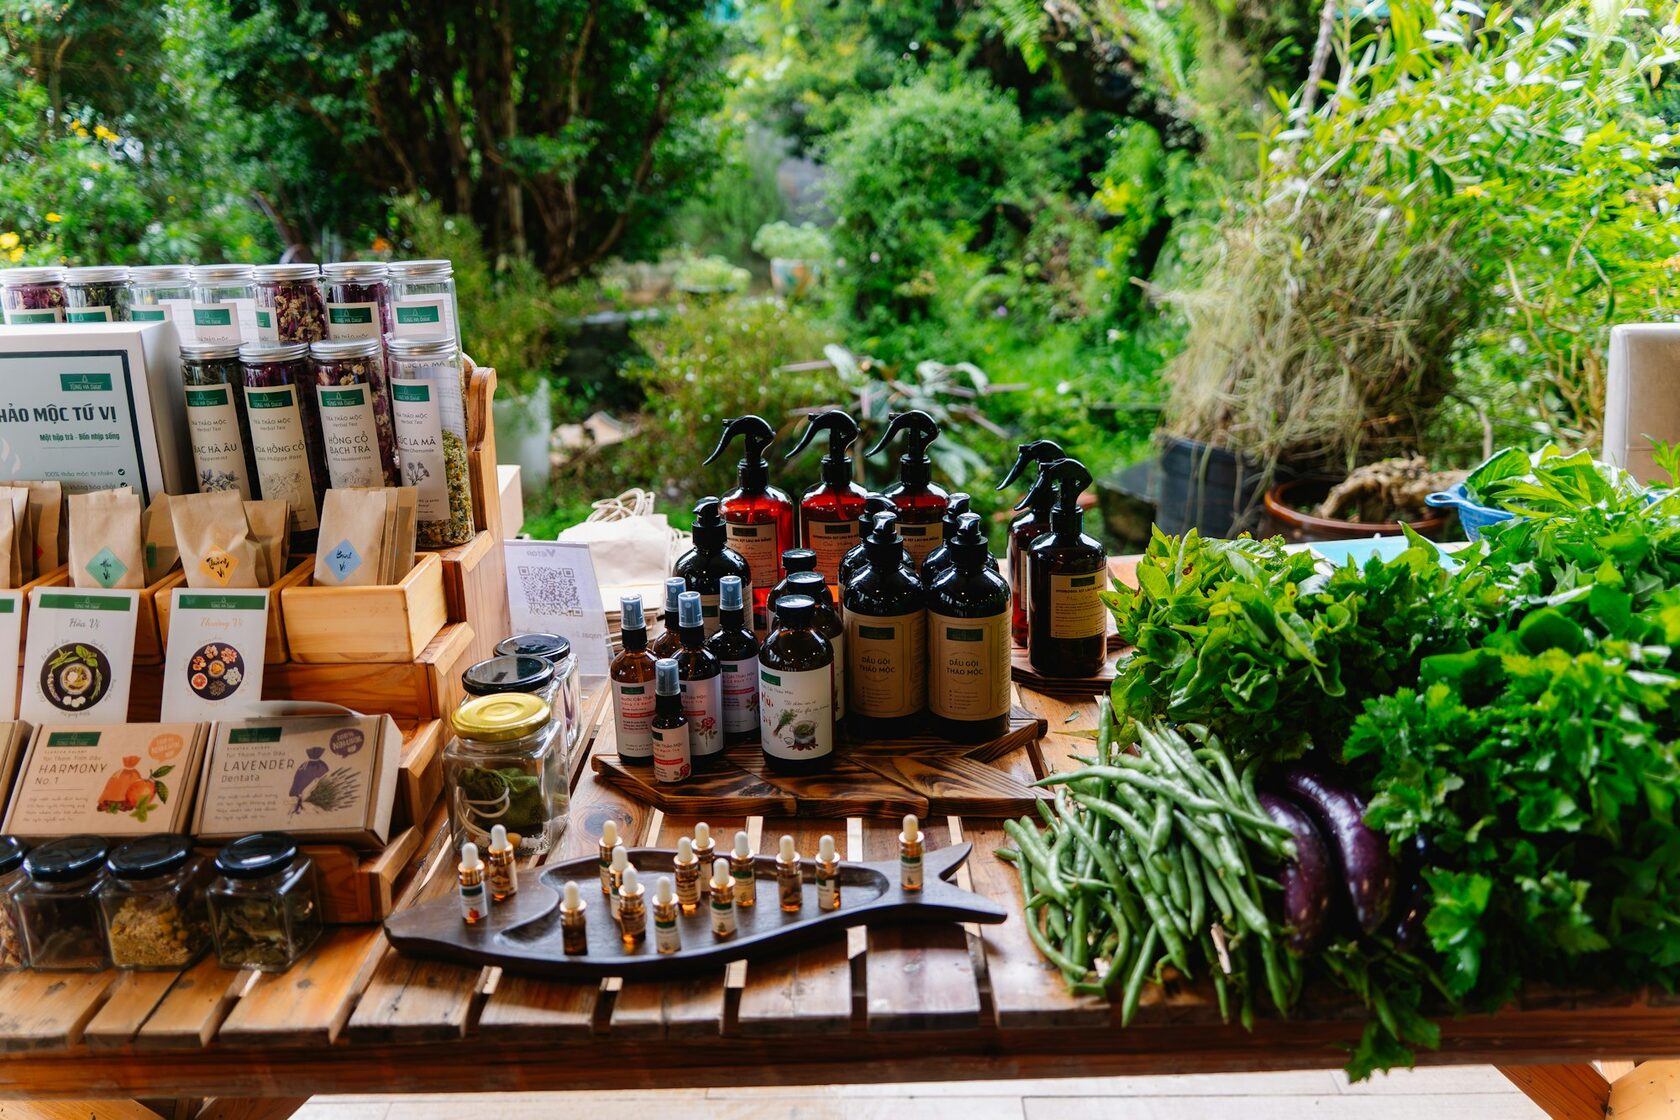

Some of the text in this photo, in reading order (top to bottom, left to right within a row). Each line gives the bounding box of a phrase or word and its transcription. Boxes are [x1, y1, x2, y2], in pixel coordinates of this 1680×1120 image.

[33, 403, 69, 424] MỘC
[72, 403, 94, 421] TỨ
[98, 406, 117, 423] VỊ
[224, 442, 238, 452] ÂU
[409, 438, 419, 446] LA
[39, 763, 108, 774] HARMONY
[223, 758, 295, 772] LAVENDER
